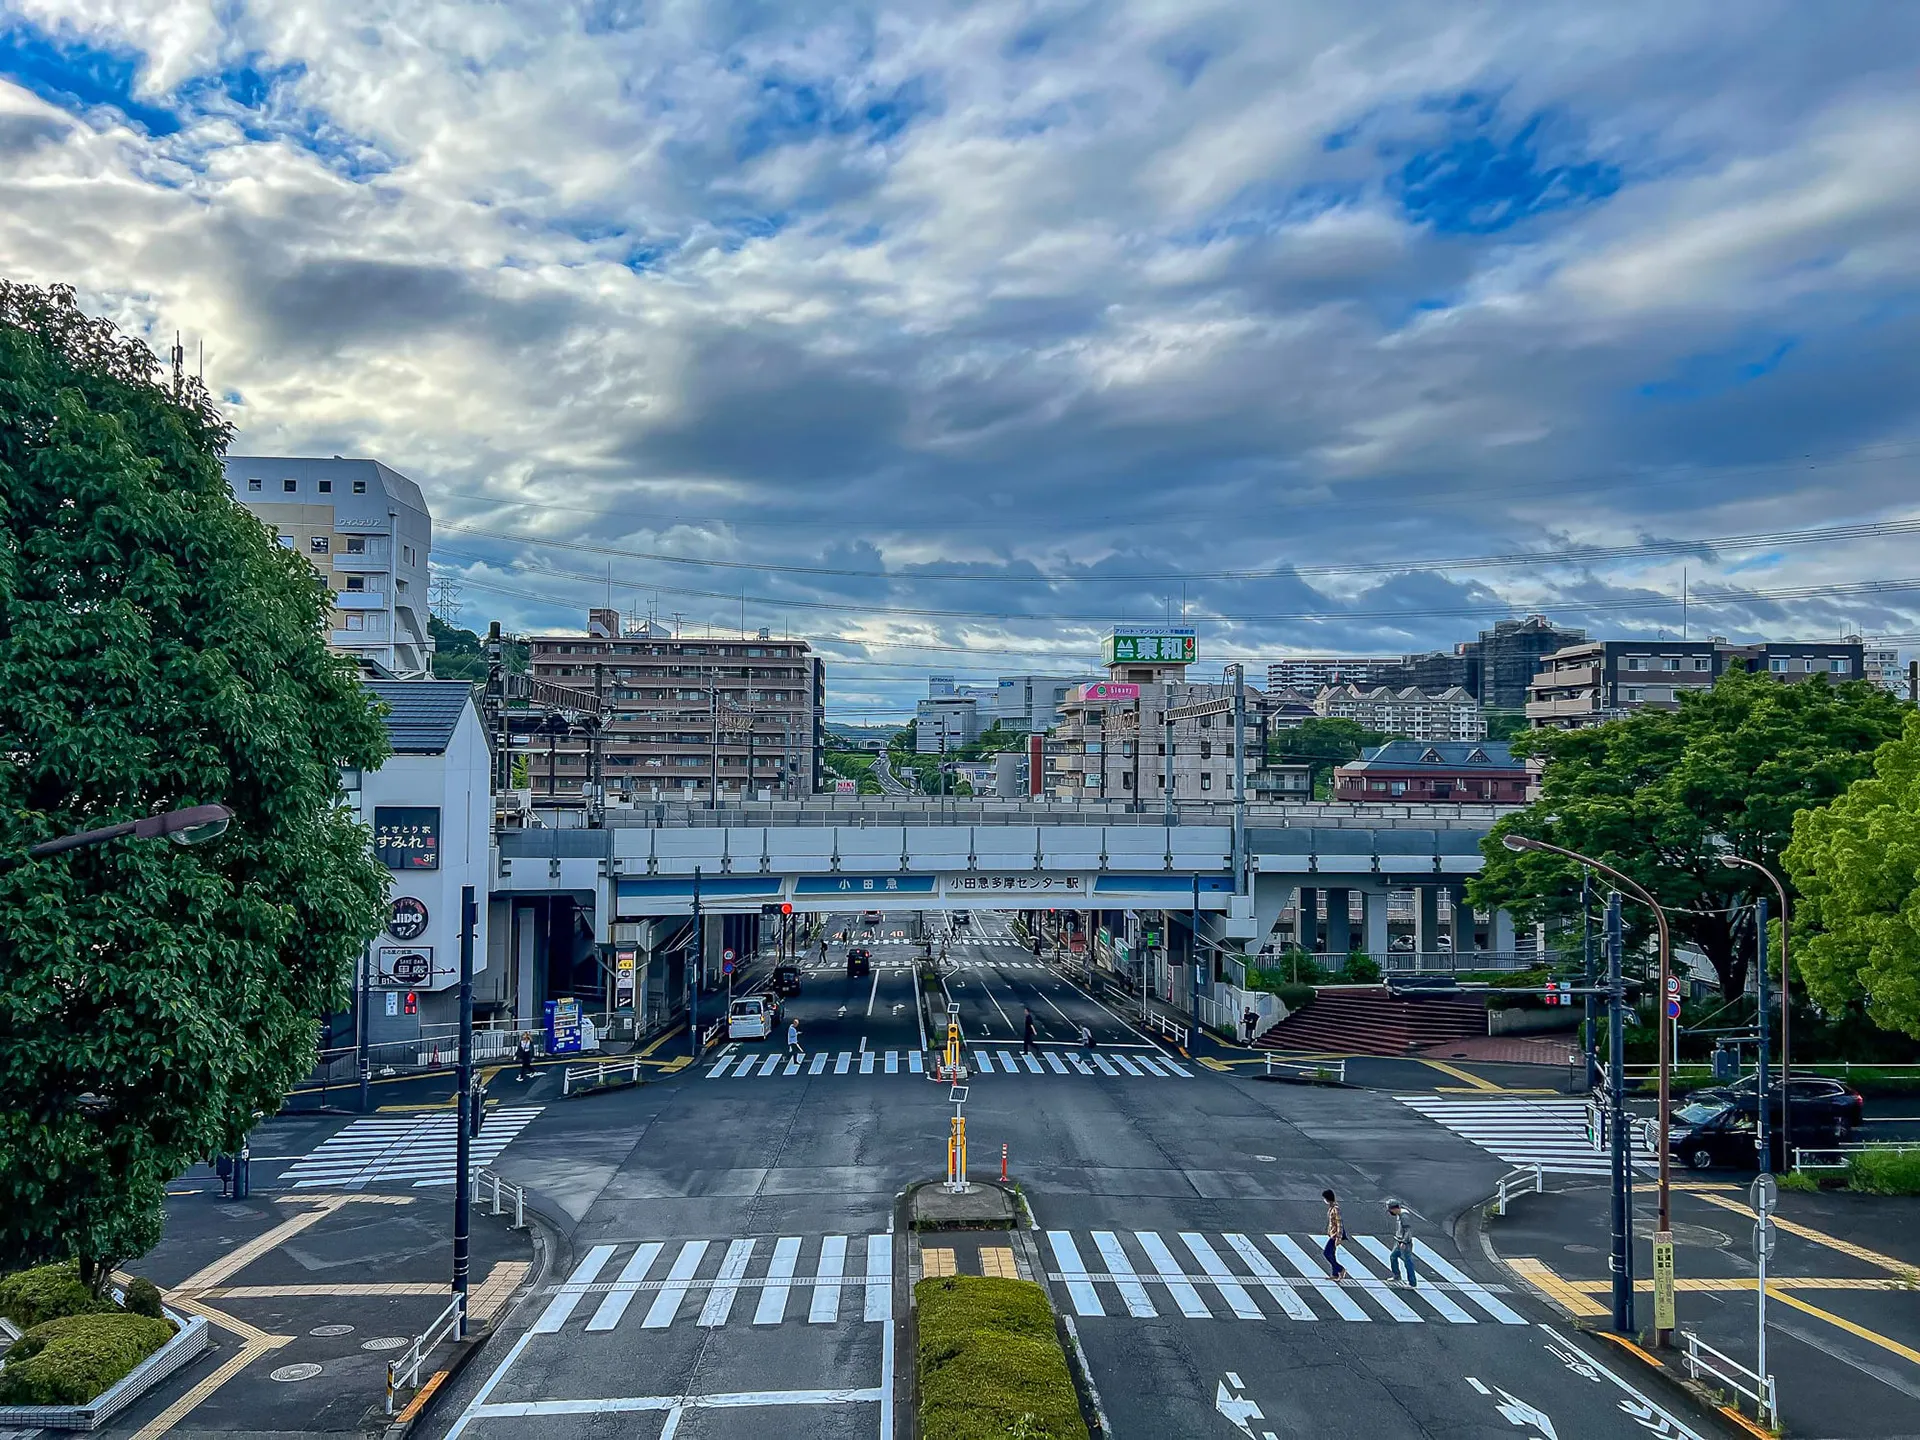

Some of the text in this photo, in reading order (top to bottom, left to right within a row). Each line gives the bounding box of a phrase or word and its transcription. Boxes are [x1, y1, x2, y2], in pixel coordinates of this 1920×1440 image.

[1136, 637, 1183, 660] 東和
[376, 835, 425, 849] すみれ
[423, 853, 436, 863] 3F
[839, 878, 898, 890] 小田急
[951, 877, 1079, 889] 小田急多摩センター駅
